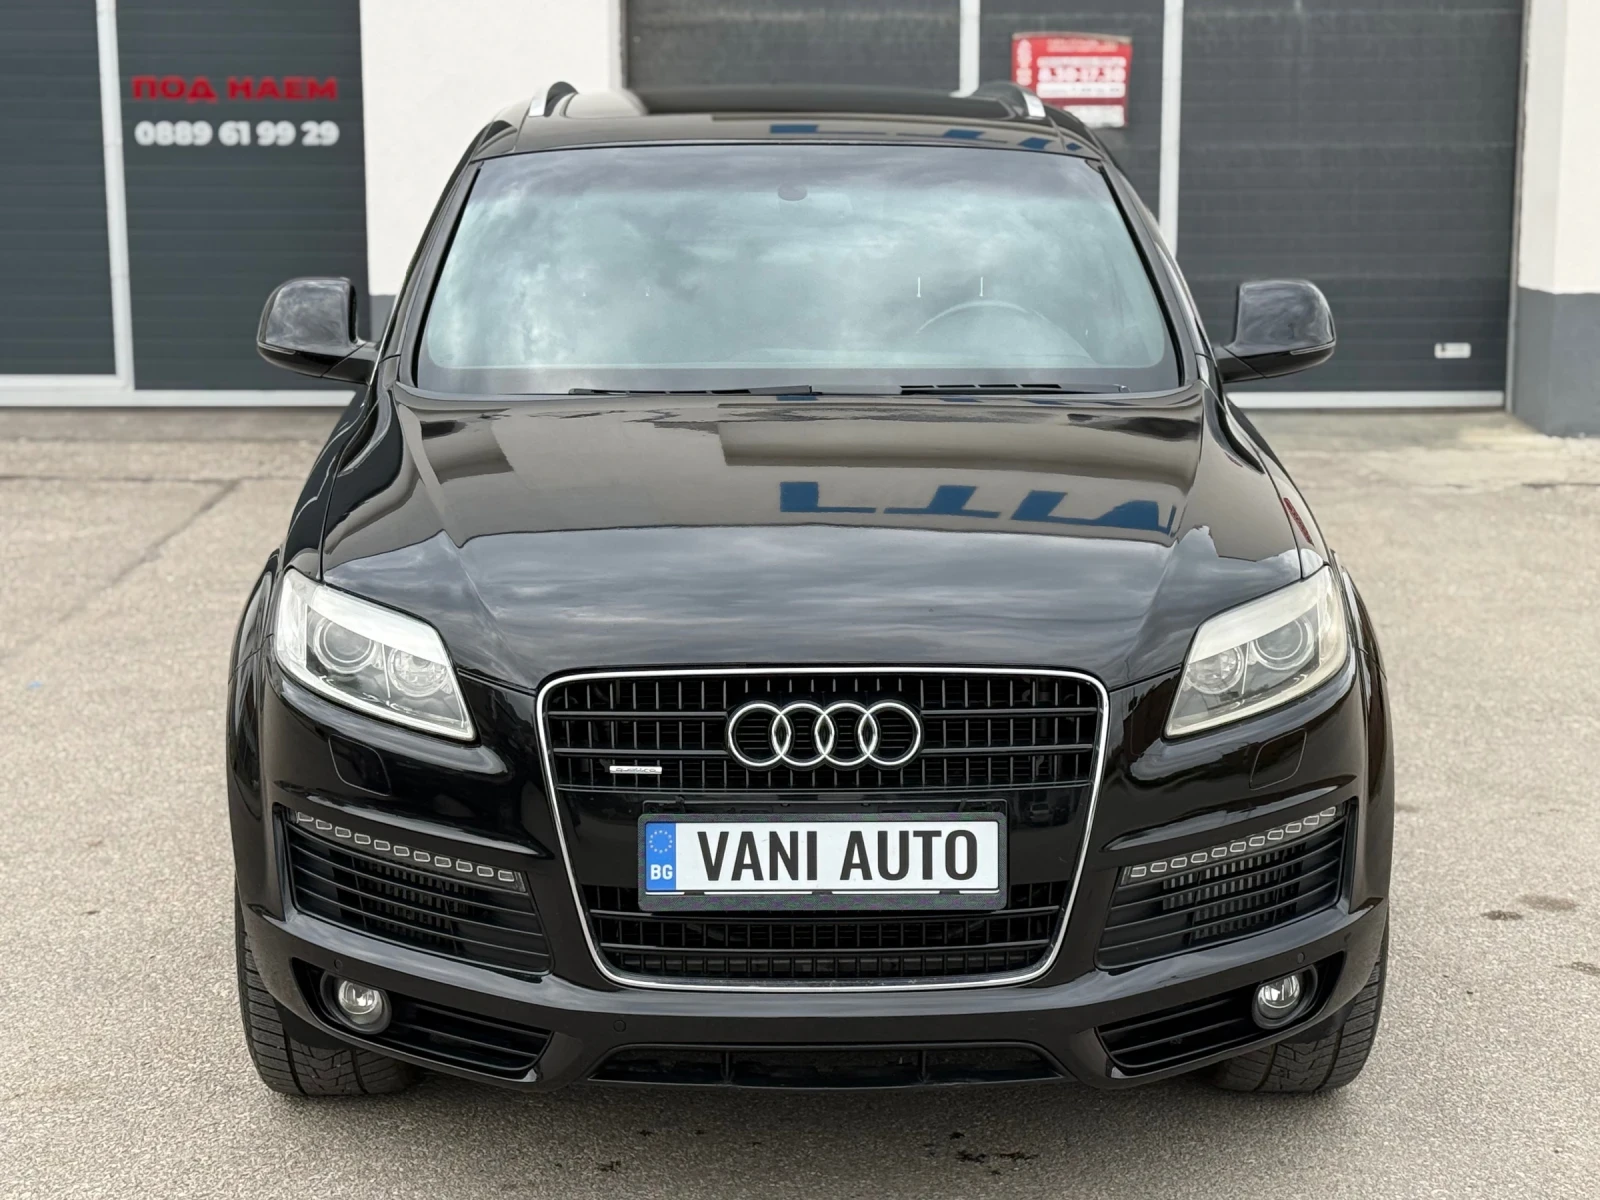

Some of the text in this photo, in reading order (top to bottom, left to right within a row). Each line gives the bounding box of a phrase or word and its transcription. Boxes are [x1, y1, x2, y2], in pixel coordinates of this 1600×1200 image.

[131, 76, 338, 103] ПОД НАЕМ
[134, 120, 340, 146] 0889 61 99 29
[697, 829, 978, 881] VANI AUTO
[650, 863, 673, 880] BG
